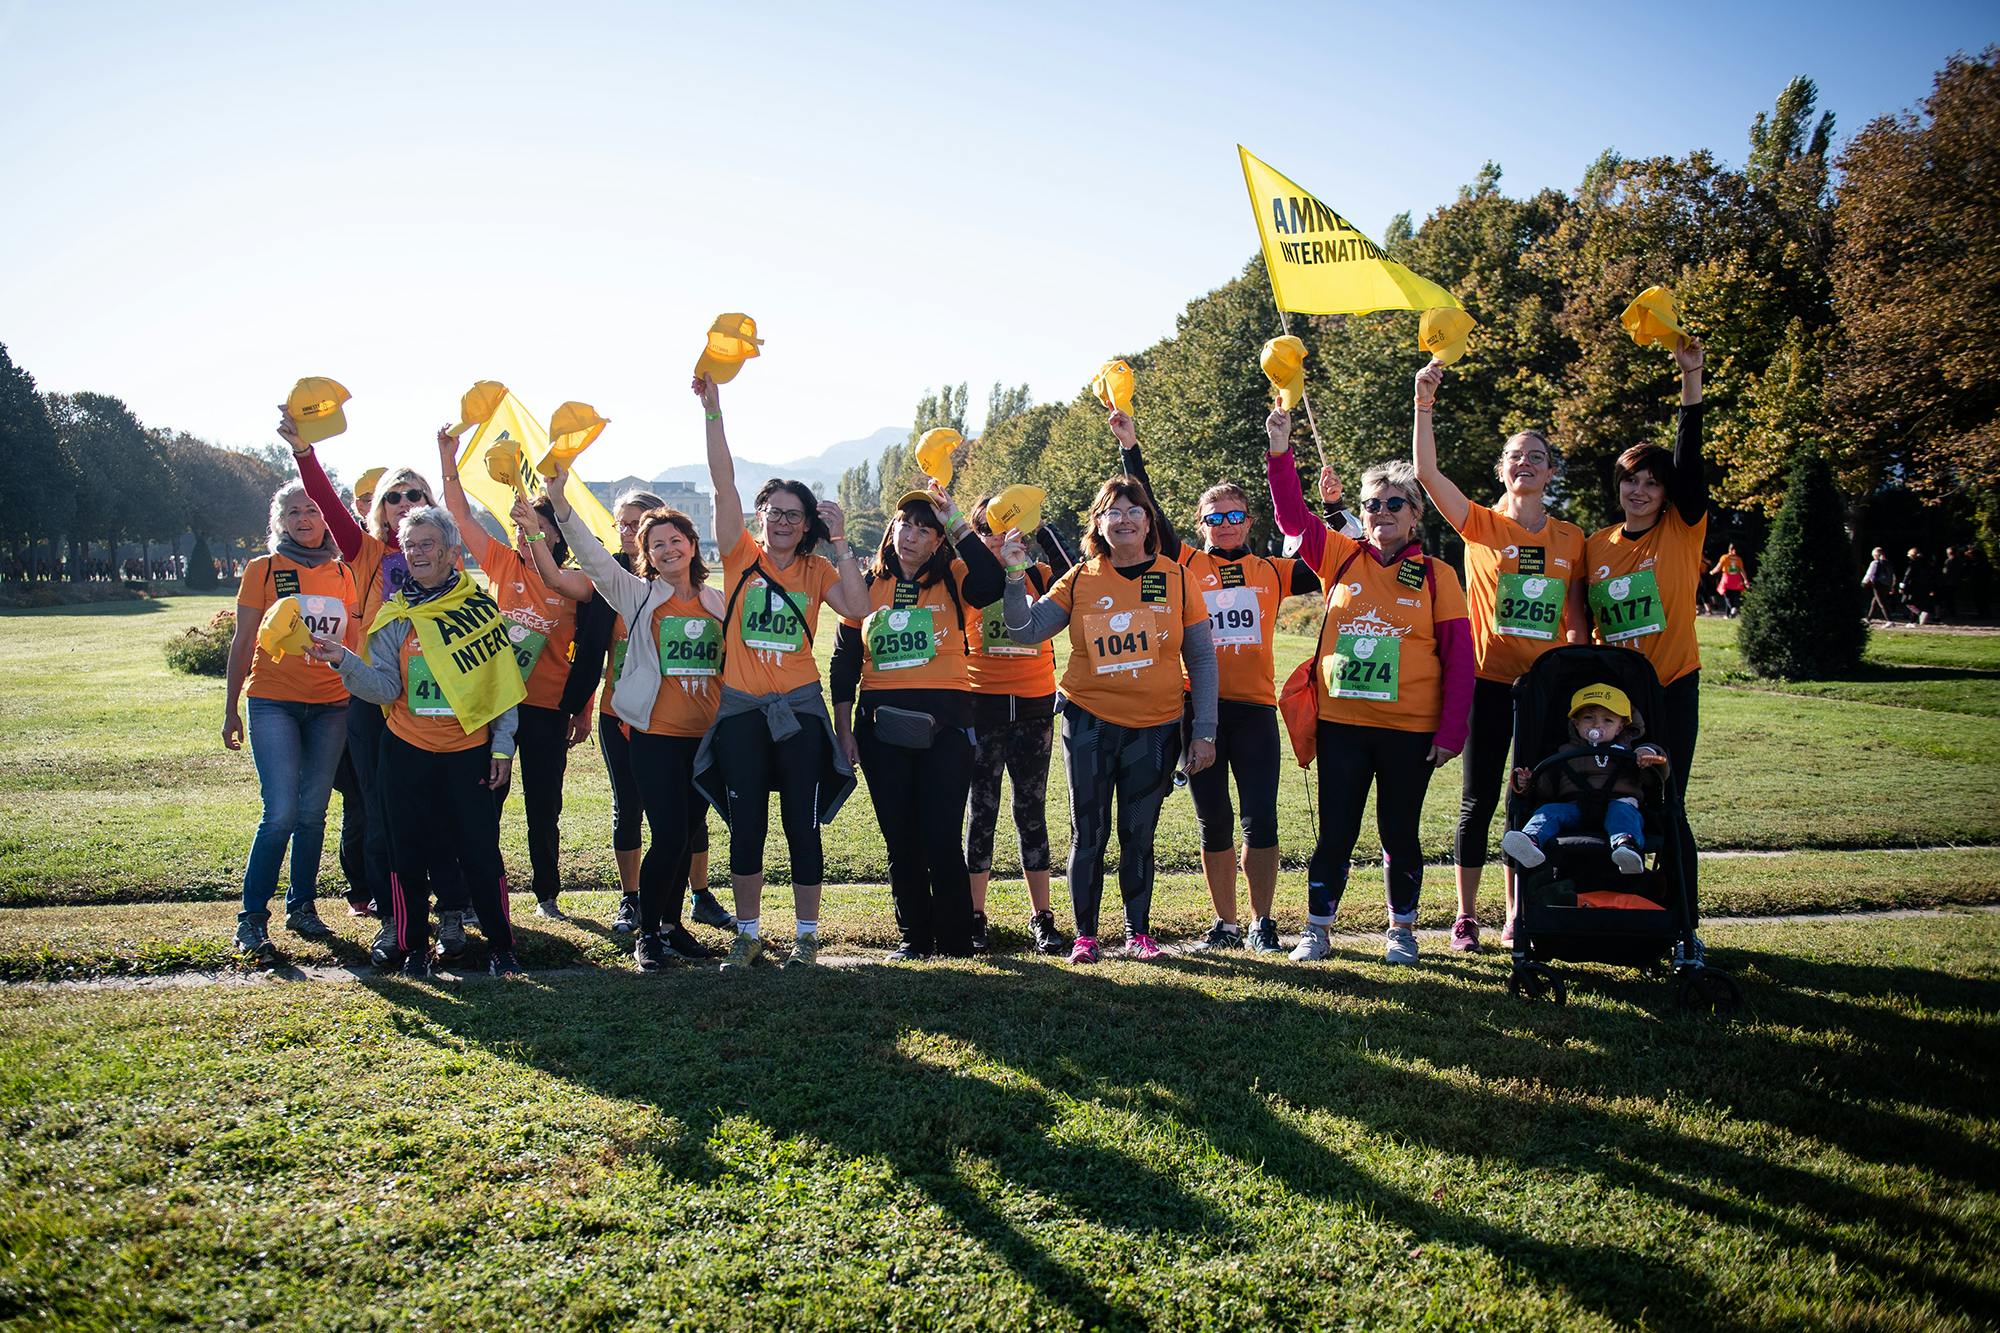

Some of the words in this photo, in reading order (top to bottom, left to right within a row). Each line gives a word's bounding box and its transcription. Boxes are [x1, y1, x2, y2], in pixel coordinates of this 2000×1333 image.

[1272, 197, 1361, 234] AMNE
[1500, 598, 1556, 623] 3265
[1601, 596, 1651, 625] 4177
[300, 616, 340, 634] 047
[746, 612, 798, 636] 4203
[667, 640, 718, 660] 2646
[874, 631, 928, 655] 2598
[1094, 630, 1148, 656] 1041
[1336, 660, 1391, 683] 3274
